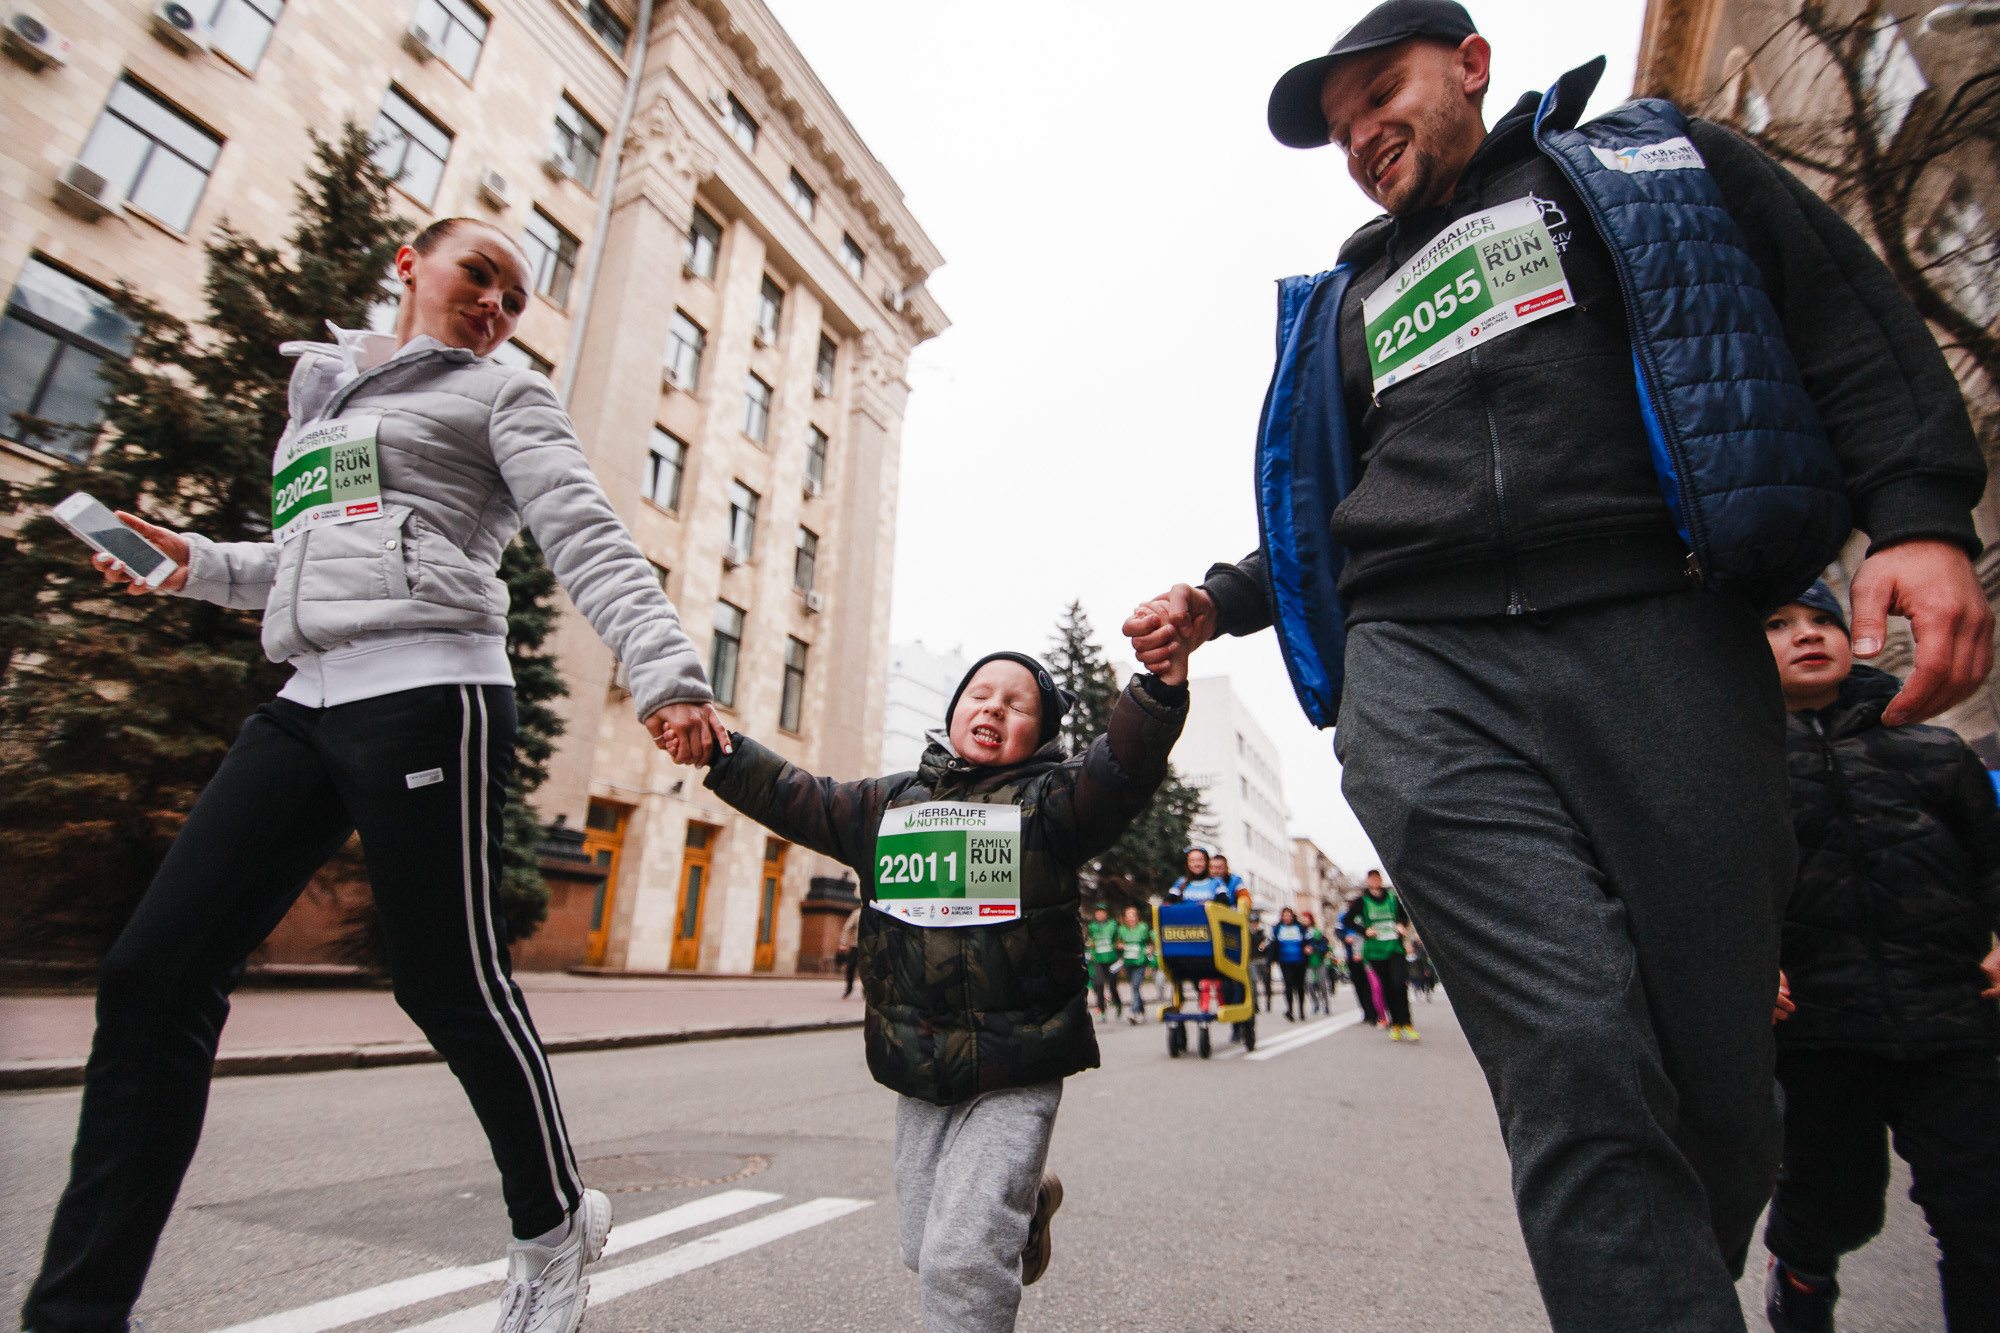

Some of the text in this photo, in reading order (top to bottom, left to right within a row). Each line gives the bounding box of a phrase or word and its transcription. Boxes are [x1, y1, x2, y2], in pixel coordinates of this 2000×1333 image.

[1411, 216, 1492, 272] HERBALIFE
[1413, 224, 1496, 279] NUTRITION
[1482, 230, 1535, 257] FAMILY
[1485, 236, 1543, 272] RUN
[1492, 256, 1549, 288] 1,6 KM
[1374, 268, 1482, 364] 22055
[1480, 310, 1507, 326] TURKISH
[1481, 316, 1509, 332] AIRLINES
[297, 424, 349, 445] HERBALIFE
[335, 446, 368, 458] FAMILY
[335, 454, 370, 473] RUN
[276, 466, 328, 516] 22022
[335, 474, 372, 490] 1,6 KM
[916, 817, 986, 828] NUTRITION
[918, 808, 986, 818] HERBALIFE
[970, 838, 1012, 848] FAMILY
[970, 848, 1012, 864] RUN
[880, 852, 957, 884] 22011
[970, 870, 1012, 884] 1,6 KM
